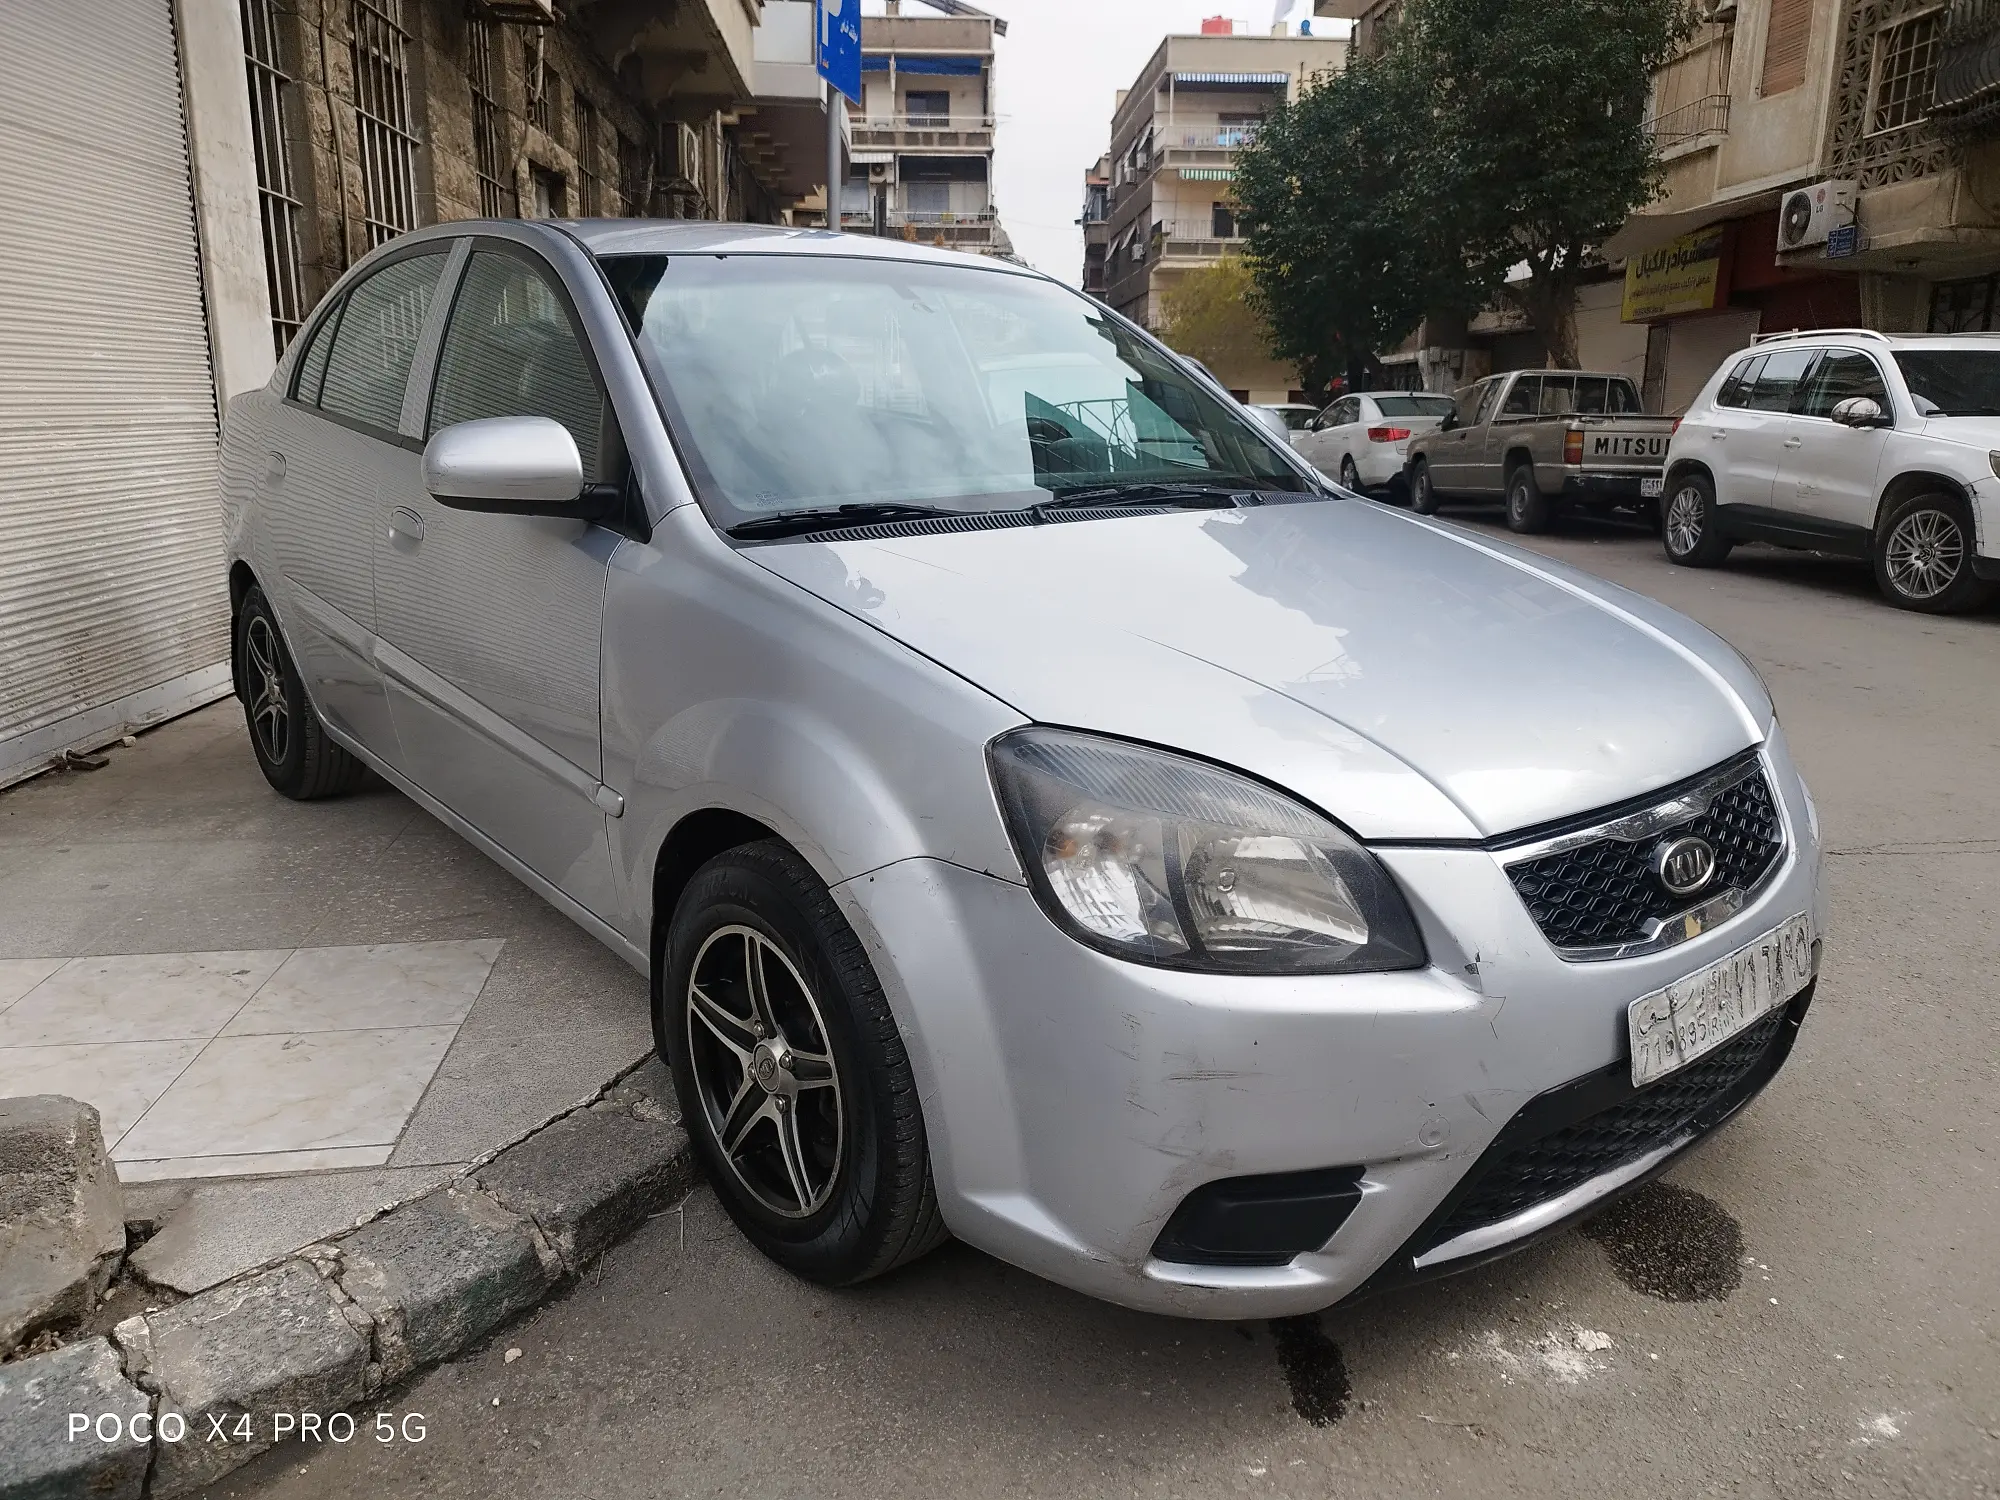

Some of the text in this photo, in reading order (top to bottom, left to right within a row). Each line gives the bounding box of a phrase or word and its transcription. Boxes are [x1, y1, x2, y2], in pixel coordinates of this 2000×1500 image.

[1816, 205, 1824, 213] LG
[1636, 249, 1667, 279] الكيال
[1668, 846, 1709, 886] KIA
